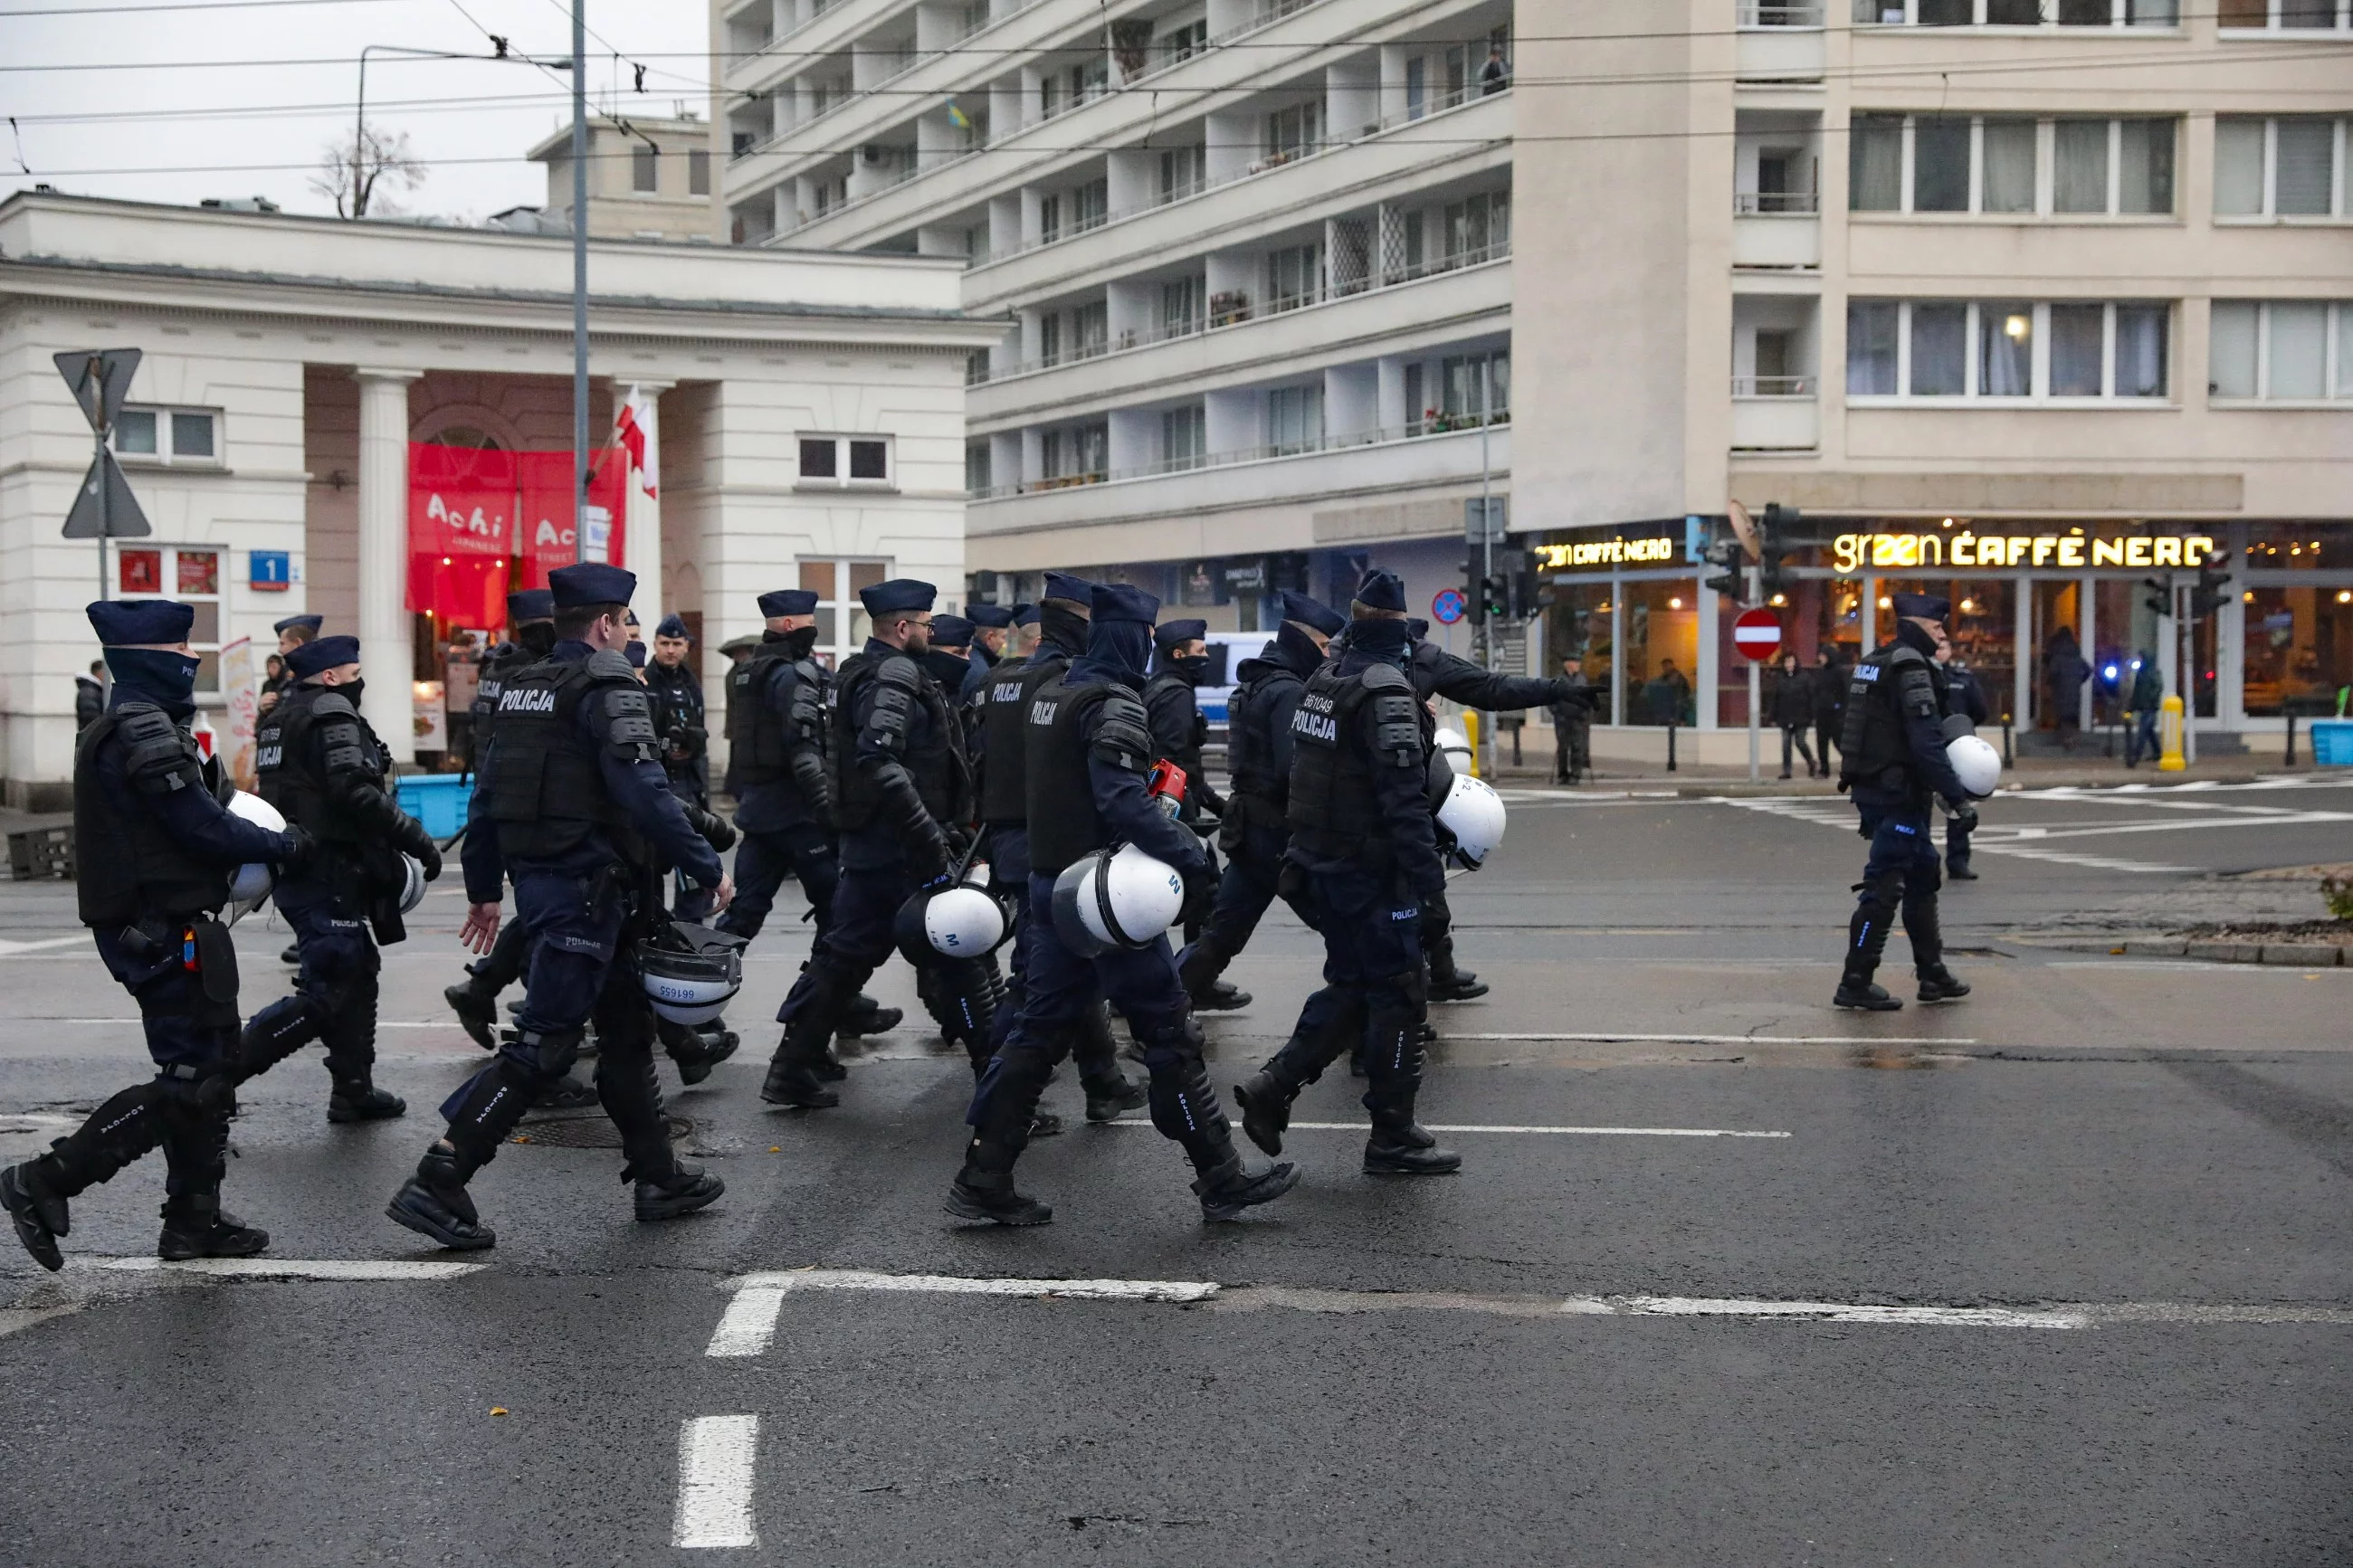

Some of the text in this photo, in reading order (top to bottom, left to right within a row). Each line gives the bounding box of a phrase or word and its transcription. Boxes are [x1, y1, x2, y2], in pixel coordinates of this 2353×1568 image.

[426, 493, 502, 537] Achi
[535, 519, 576, 546] Ac
[1624, 538, 1672, 561] NERO
[1834, 534, 1941, 573] green
[265, 560, 276, 581] 1
[498, 689, 556, 712] POLICJA
[992, 682, 1023, 702] POLICJA
[1303, 694, 1333, 713] 661049
[1030, 700, 1057, 726] POLICJA
[1291, 708, 1336, 741] POLICJA
[1391, 908, 1418, 921] POLICJA
[565, 936, 601, 950] POLICJA
[660, 985, 695, 1000] 661655
[1394, 1031, 1404, 1069] POLICJA
[475, 1086, 508, 1124] POLICJA
[1178, 1093, 1196, 1131] POLICJA
[100, 1104, 145, 1135] POLICJA
